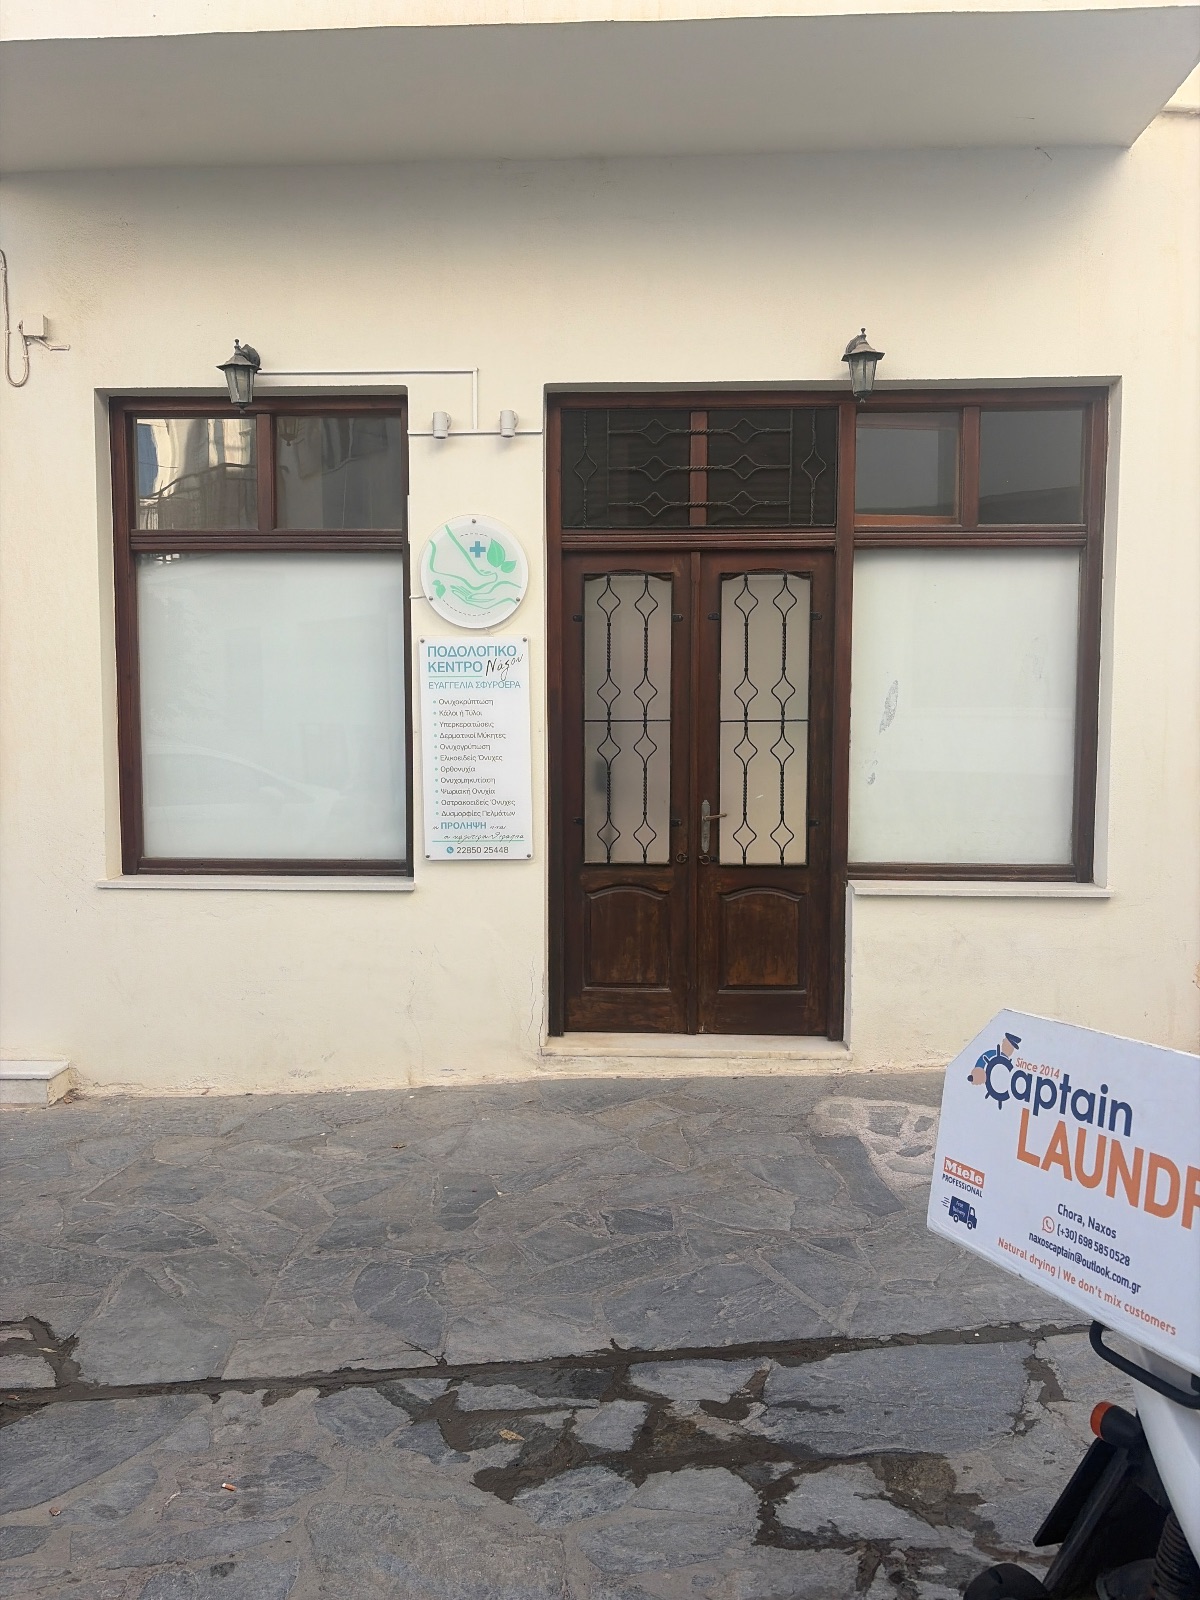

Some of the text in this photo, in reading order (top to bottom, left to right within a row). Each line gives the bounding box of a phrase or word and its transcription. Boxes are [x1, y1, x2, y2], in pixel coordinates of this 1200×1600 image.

[427, 645, 517, 658] ΠΟΔΟΛΟΓΙΚΟ
[428, 661, 483, 673] ΚΕΝΤΡΟ
[428, 680, 521, 690] ΕΥΑΓΓΕΛΙΑ ΣΦΥΡΟΕΡΑ
[438, 698, 494, 706] Ονυχοκρύπτωση
[439, 720, 495, 728] Υπερκερατώσεις
[476, 732, 507, 740] Μύκητες
[440, 821, 487, 830] ΠΡΟΛΗΨΗ
[456, 846, 509, 854] 22850 25448
[1015, 1057, 1060, 1079] Since 2014
[984, 1044, 1133, 1137] Captain
[944, 1159, 983, 1185] Miele
[942, 1173, 983, 1198] PROFESSIONAL
[1057, 1203, 1117, 1239] Chora, Naxos
[1057, 1223, 1130, 1267] (+30) 698 585 0528
[1028, 1231, 1141, 1295] naxoscaptain@outlook.com.gr
[998, 1237, 1027, 1260] Natural
[1029, 1252, 1056, 1277] drying
[1062, 1269, 1076, 1285] We
[1078, 1279, 1102, 1299] don't
[1103, 1291, 1122, 1309] mix
[1123, 1302, 1176, 1336] customers
